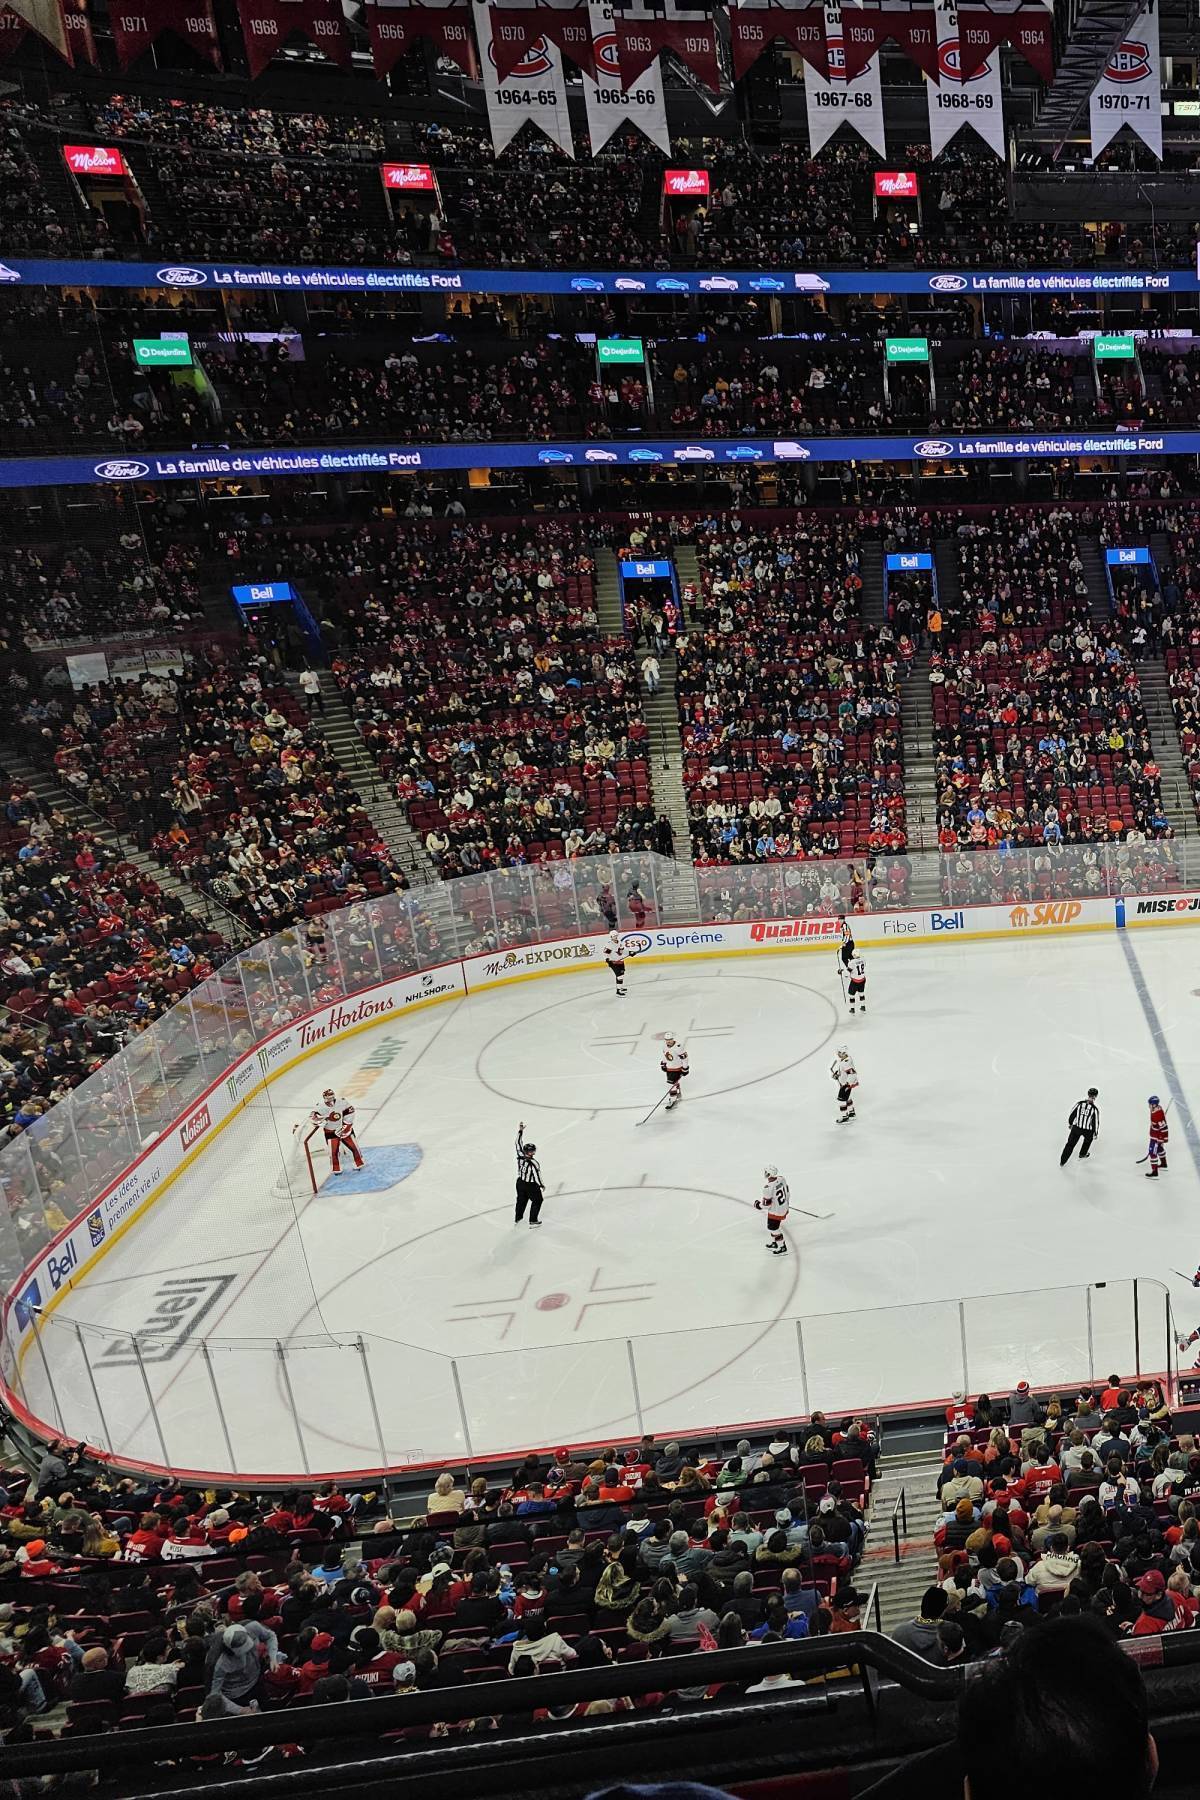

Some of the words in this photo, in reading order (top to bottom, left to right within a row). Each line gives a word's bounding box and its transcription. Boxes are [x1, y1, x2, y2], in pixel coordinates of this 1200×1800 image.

[119, 17, 148, 33] 1971
[185, 18, 214, 33] 1985
[250, 19, 279, 35] 1968
[312, 20, 340, 36] 1982
[377, 24, 405, 40] 1966
[443, 26, 467, 40] 1981
[738, 26, 764, 40] 1955
[500, 27, 525, 41] 1970
[564, 27, 588, 42] 1979
[796, 26, 821, 41] 1975
[850, 28, 876, 43] 1950
[910, 28, 932, 43] 1971
[966, 30, 990, 44] 1950
[1021, 30, 1045, 45] 1964
[625, 37, 652, 52] 1963
[686, 38, 710, 53] 1979
[495, 90, 557, 106] 1964-65
[594, 90, 656, 106] 1965-66
[815, 92, 873, 108] 1967-68
[936, 93, 995, 109] 1968-69
[1098, 95, 1151, 110] 1970-71
[71, 153, 116, 170] Molson
[388, 168, 428, 184] Molson
[670, 176, 705, 191] Molson
[880, 177, 912, 192] Molson
[164, 268, 203, 284] Ford
[214, 271, 232, 284] La
[237, 271, 280, 285] famille
[284, 272, 301, 286] de
[302, 272, 365, 286] véhicules
[366, 273, 430, 288] électrifiés
[432, 274, 461, 288] Ford
[973, 278, 986, 289] La
[987, 277, 1026, 289] famille
[1028, 277, 1041, 289] de
[1042, 276, 1091, 289] véhicules
[1093, 275, 1144, 288] électrifiés
[1145, 276, 1169, 287] Ford
[150, 348, 187, 357] Desjardins
[611, 347, 640, 356] Desjardins
[898, 346, 925, 354] Desjardins
[1105, 344, 1131, 352] Desjardins
[920, 443, 947, 455] Ford
[959, 442, 973, 454] La
[974, 442, 1014, 454] famille
[1015, 441, 1029, 453] de
[1030, 440, 1082, 453] véhicules
[1083, 439, 1137, 451] électrifiés
[1138, 439, 1163, 450] Ford
[104, 463, 142, 477] Ford
[157, 461, 177, 475] La
[178, 459, 231, 475] famille
[232, 458, 251, 472] de
[252, 455, 319, 472] véhicules
[320, 452, 388, 468] électrifiés
[389, 451, 421, 466] Ford
[900, 556, 918, 568] Bell
[1119, 550, 1136, 562] Bell
[636, 564, 656, 576] Bell
[251, 586, 275, 601] Bell
[1030, 902, 1082, 927] SKIP
[750, 920, 843, 942] Qualinet
[883, 920, 917, 934] Fibe
[931, 912, 965, 931] Bell
[624, 939, 648, 949] Esso
[656, 931, 723, 949] Suprême
[482, 955, 524, 976] Molson
[525, 946, 582, 966] EXPORT
[405, 984, 456, 1003] NHLSHOP.CA
[296, 1020, 326, 1048] Tim
[328, 996, 395, 1033] Hortons
[105, 1194, 118, 1212] Les
[119, 1174, 139, 1198] idées
[108, 1188, 141, 1230] prennent
[140, 1178, 152, 1194] vie
[150, 1166, 161, 1182] ici
[93, 1229, 105, 1247] RBC
[47, 1238, 78, 1290] Bell
[101, 1286, 208, 1357] Fuel
